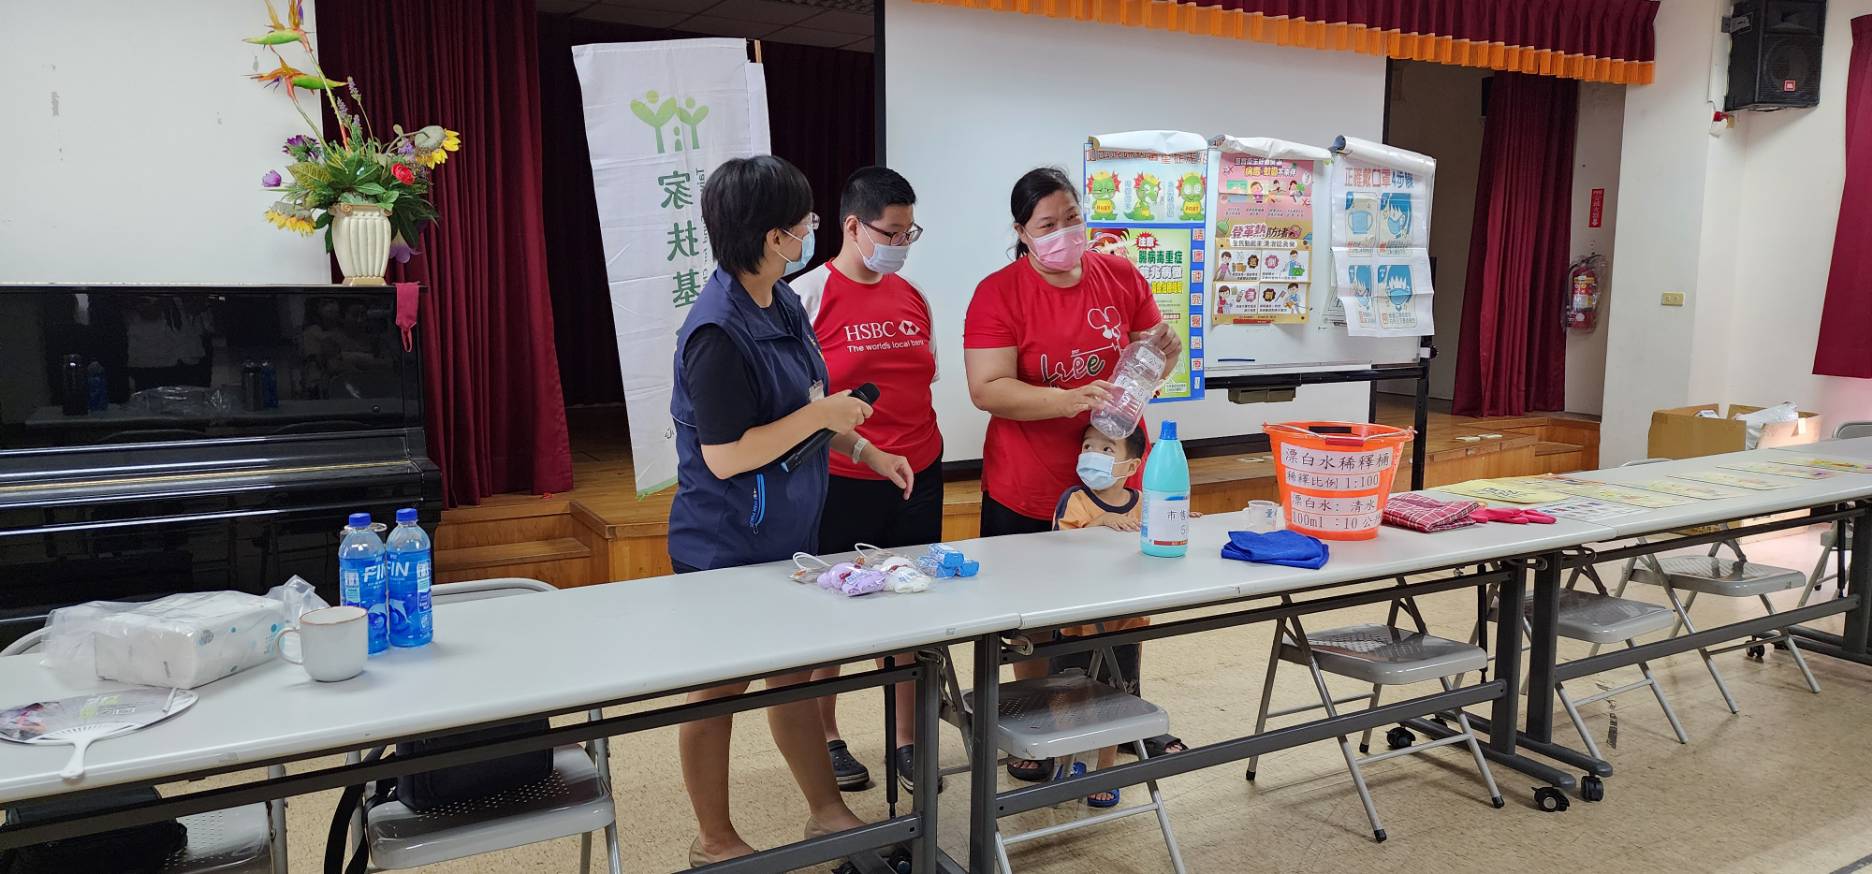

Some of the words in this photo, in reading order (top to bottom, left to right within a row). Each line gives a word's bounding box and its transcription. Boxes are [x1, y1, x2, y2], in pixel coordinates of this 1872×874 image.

[657, 170, 701, 336] 家扶基
[844, 321, 897, 341] HSBC
[847, 345, 865, 353] The
[1285, 447, 1390, 472] 漂白水稀釋桶
[1287, 470, 1339, 490] 稀釋比例
[1346, 473, 1379, 489] 1:100
